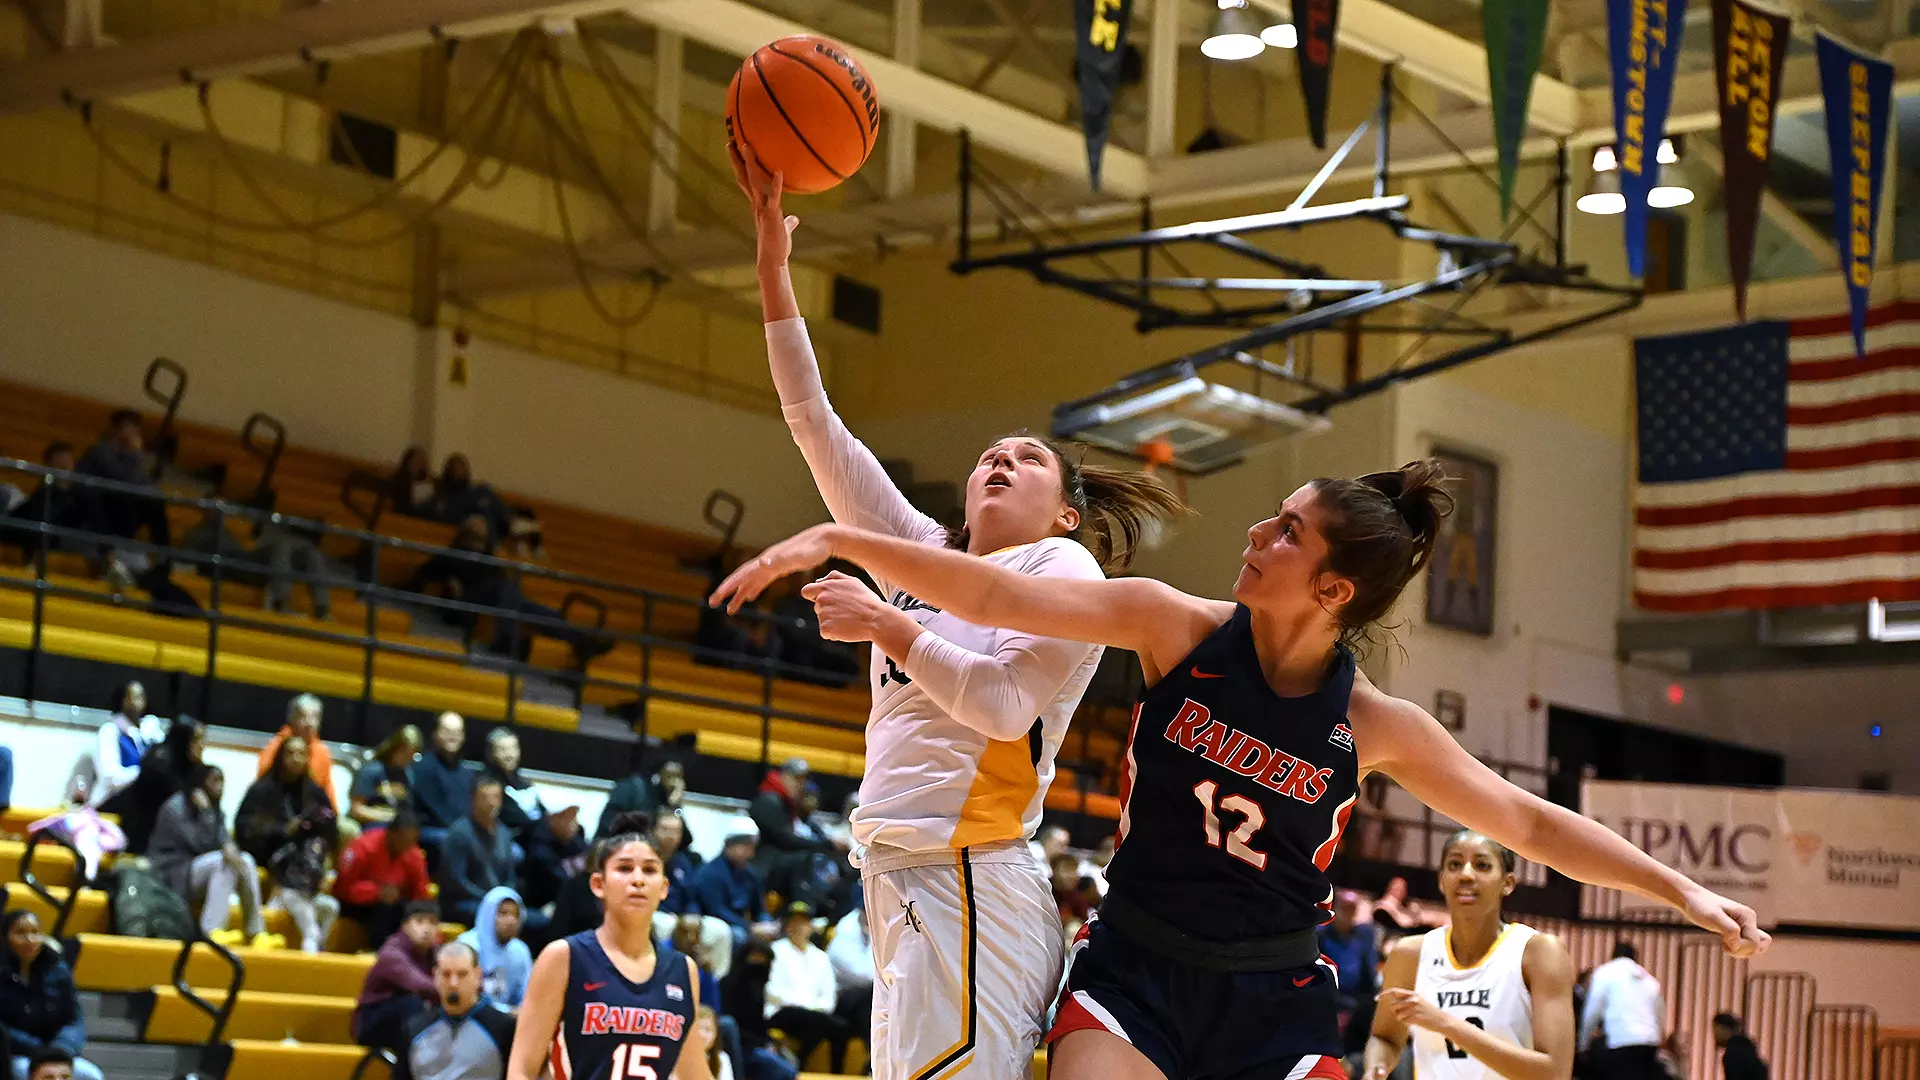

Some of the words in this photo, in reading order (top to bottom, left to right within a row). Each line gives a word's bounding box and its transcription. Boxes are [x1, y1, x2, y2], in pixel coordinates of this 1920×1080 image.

[1726, 3, 1751, 106] HILL
[1747, 16, 1774, 163] SETON
[1849, 62, 1872, 288] SHEPHERD
[1163, 697, 1334, 805] RAIDERS
[1192, 778, 1268, 872] 12
[581, 1002, 686, 1042] RAIDERS
[1437, 988, 1491, 1010] VILLE
[609, 1042, 661, 1080] 15
